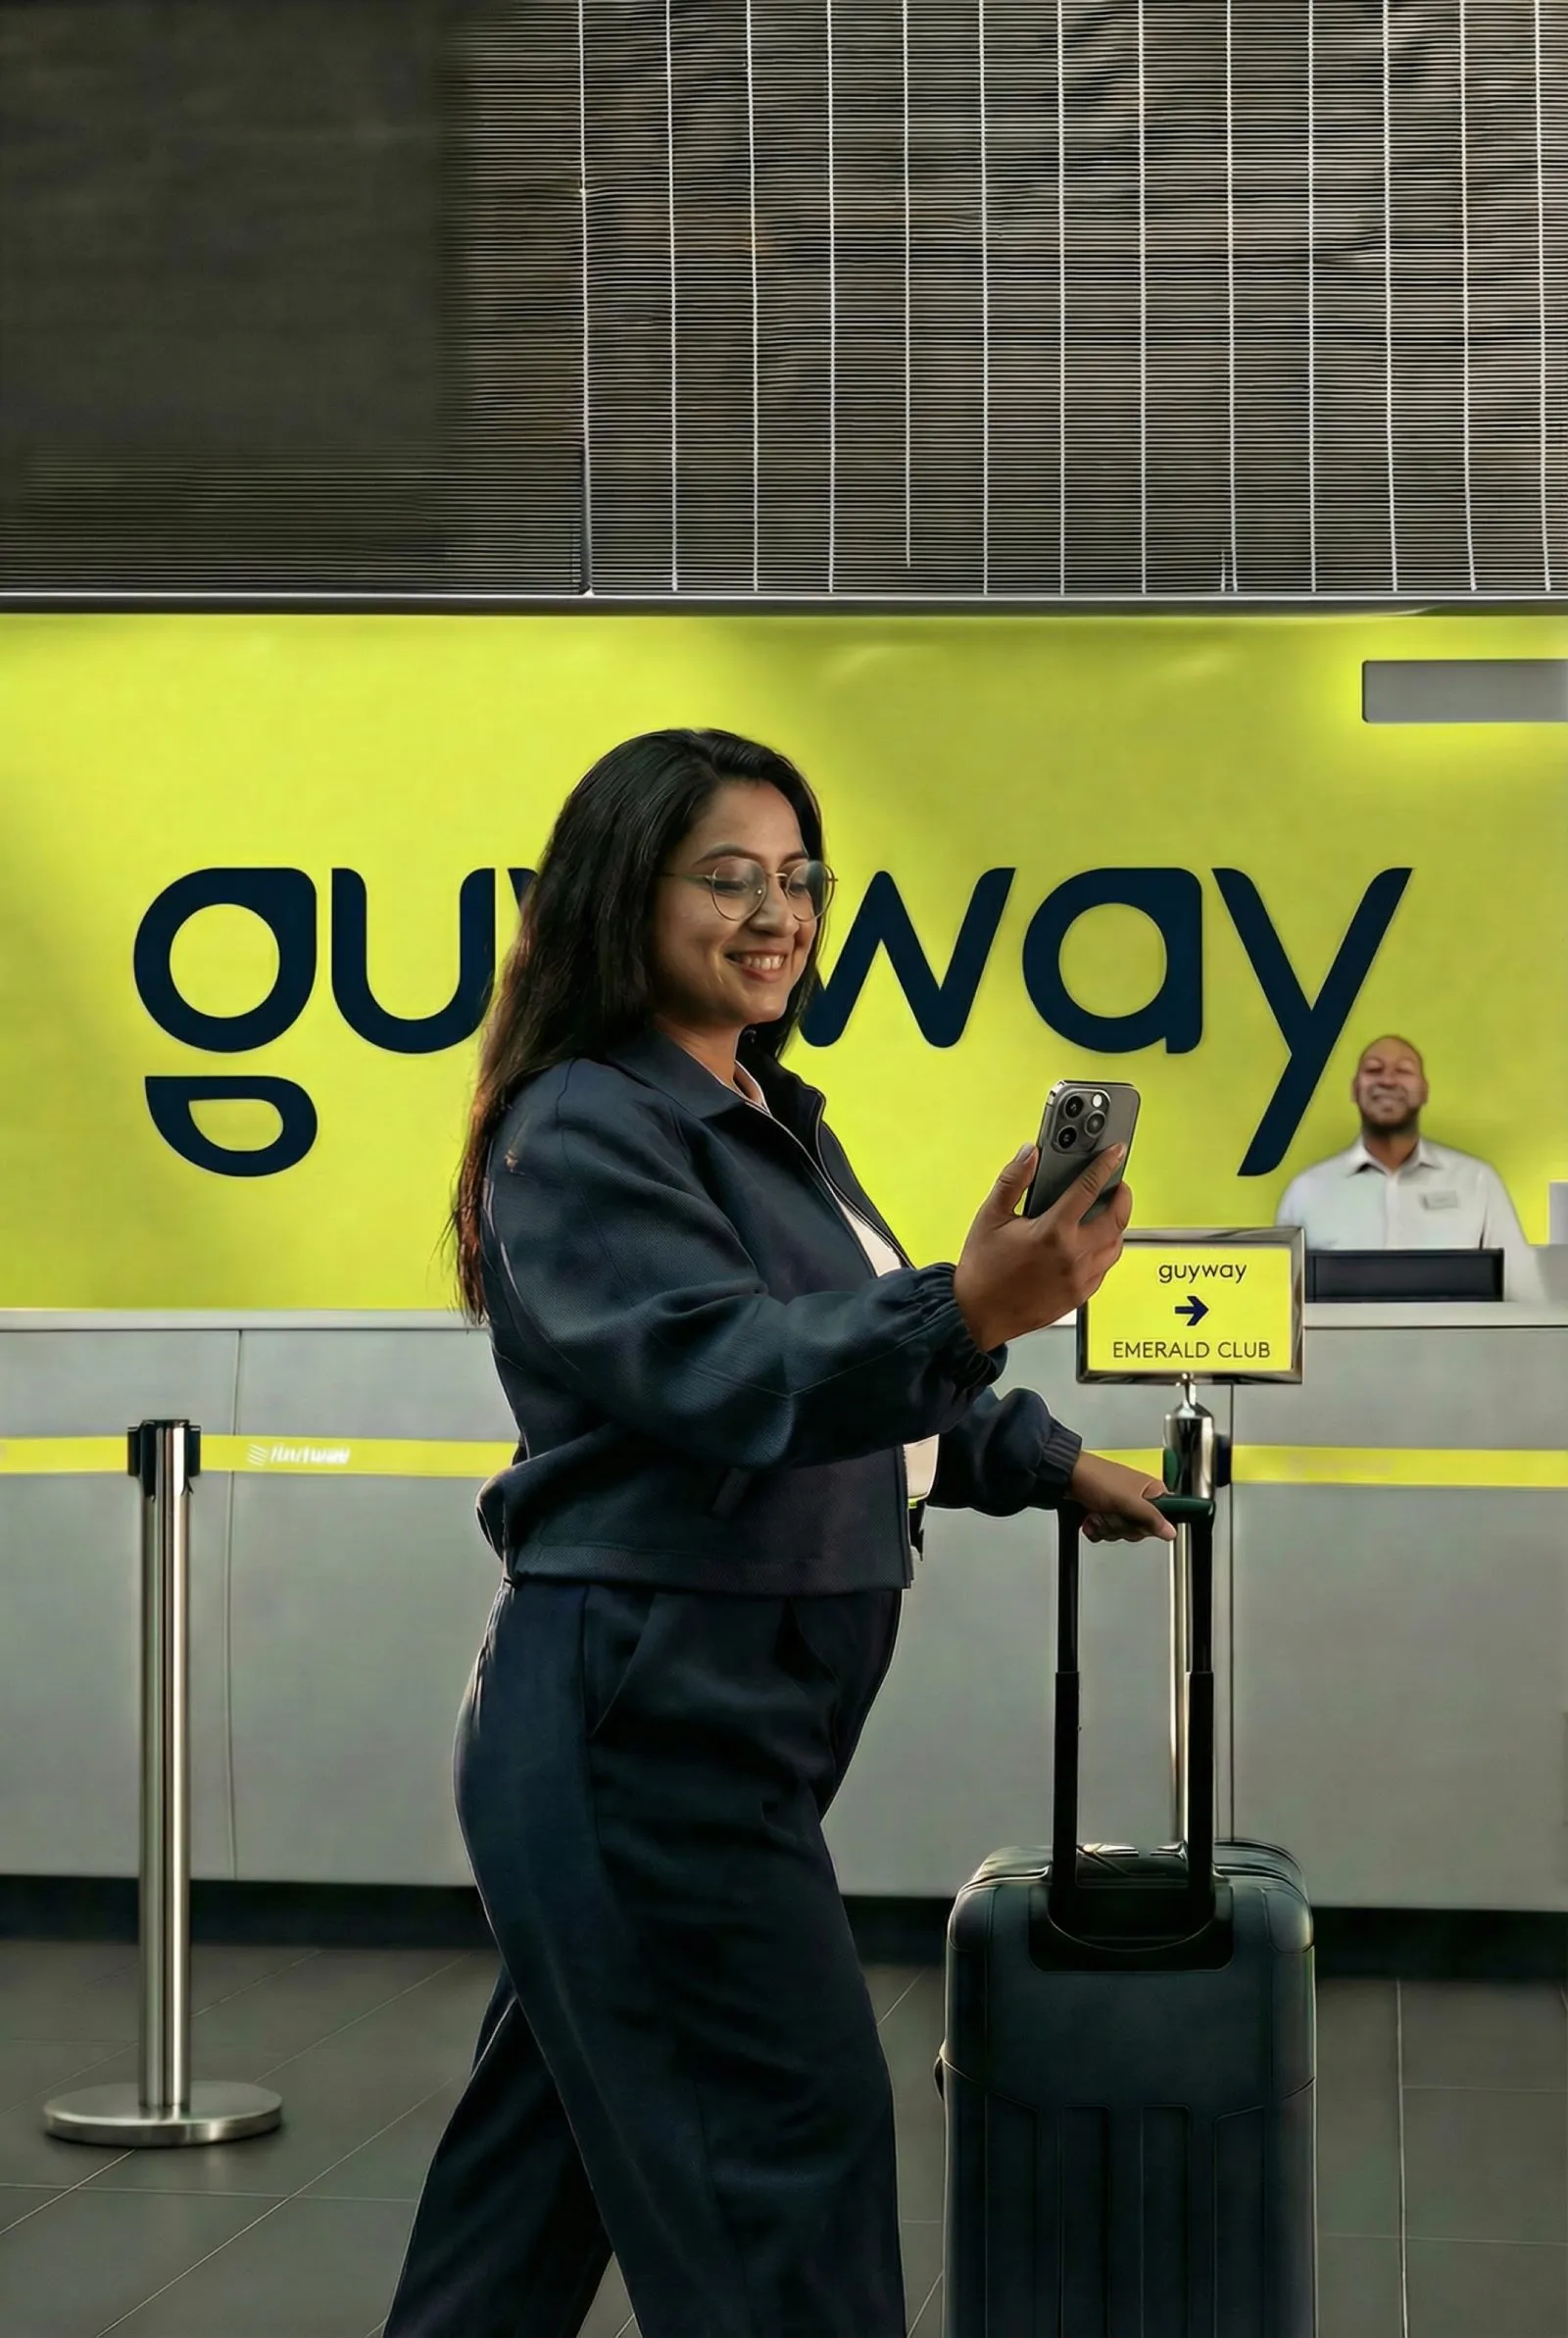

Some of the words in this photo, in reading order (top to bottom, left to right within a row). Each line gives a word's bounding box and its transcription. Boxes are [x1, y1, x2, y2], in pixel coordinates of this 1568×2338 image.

[133, 867, 1414, 1177] guway
[1158, 1264, 1248, 1284] guyway
[1113, 1341, 1210, 1359] EMERALD
[1217, 1341, 1271, 1359] CLUB
